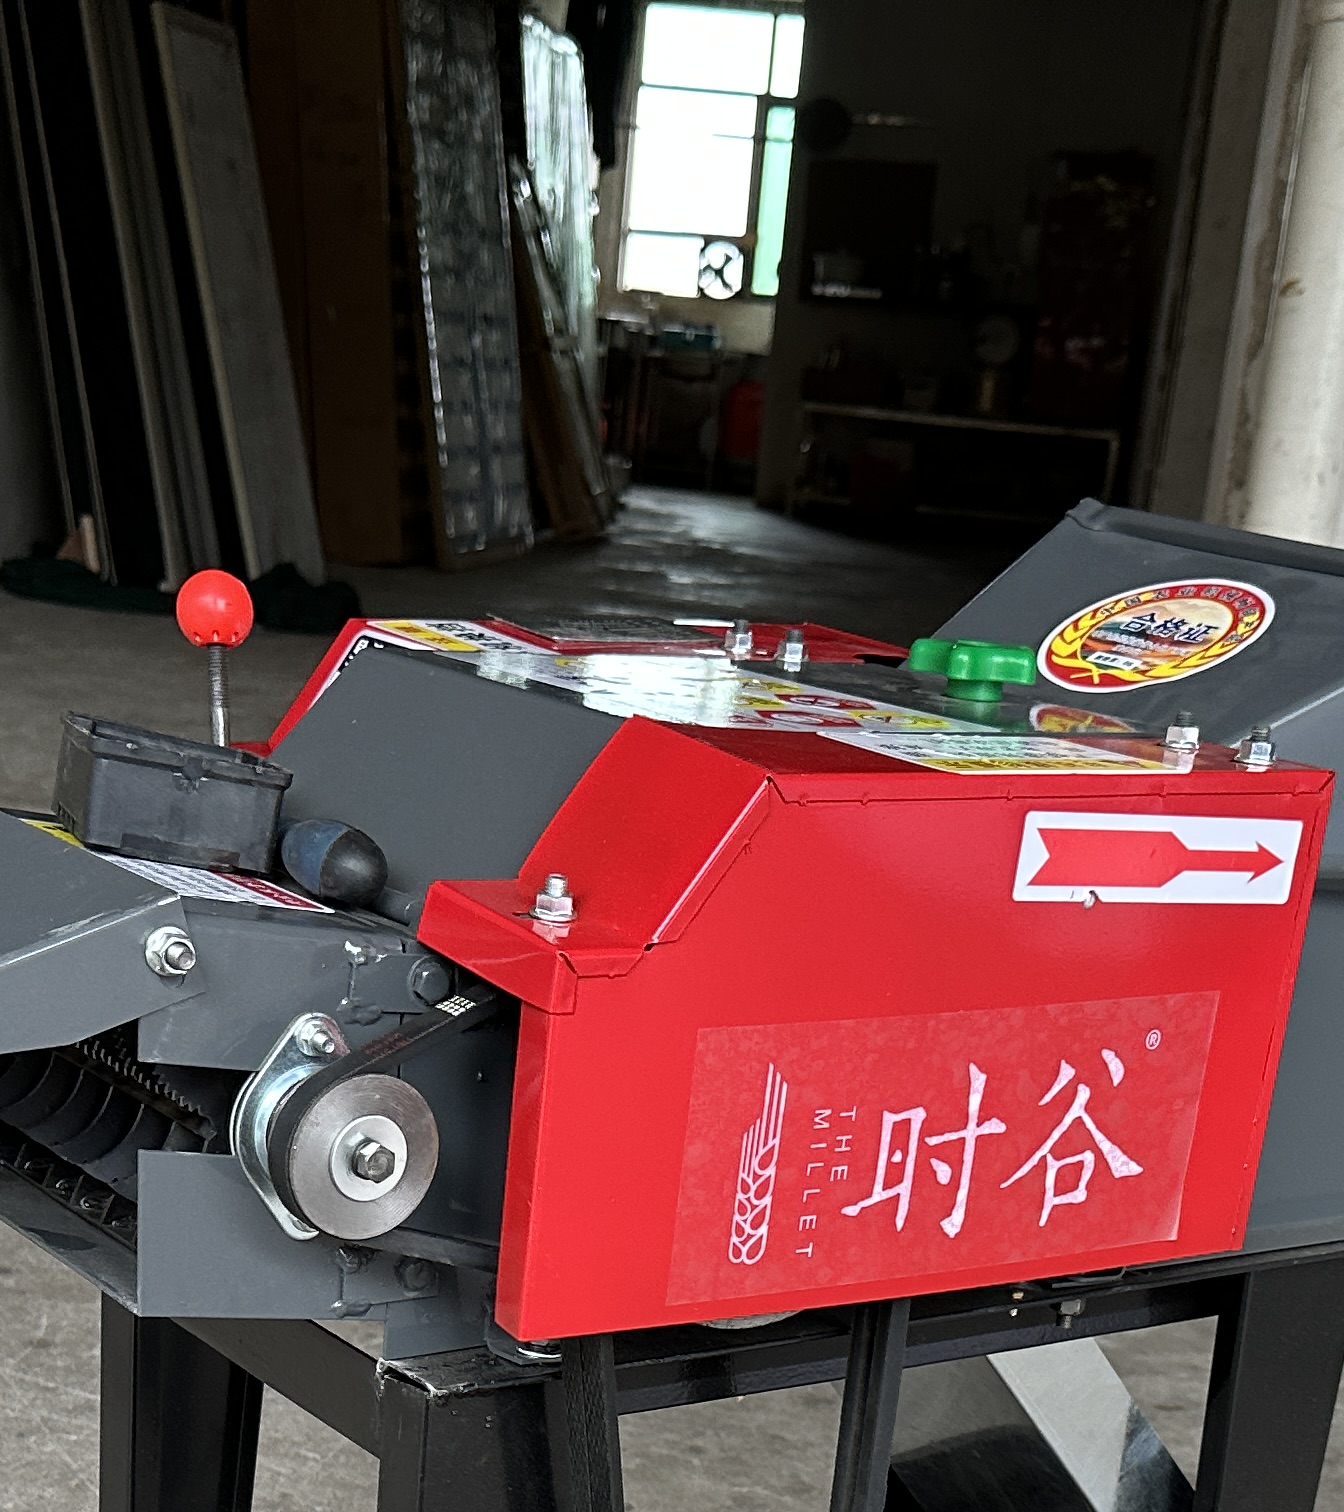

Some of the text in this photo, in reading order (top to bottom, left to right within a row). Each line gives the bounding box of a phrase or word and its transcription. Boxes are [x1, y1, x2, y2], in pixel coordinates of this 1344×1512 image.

[1120, 612, 1219, 643] 合格证
[795, 1109, 832, 1258] MILLET
[830, 1106, 856, 1182] THE
[841, 1049, 1144, 1239] 时谷
